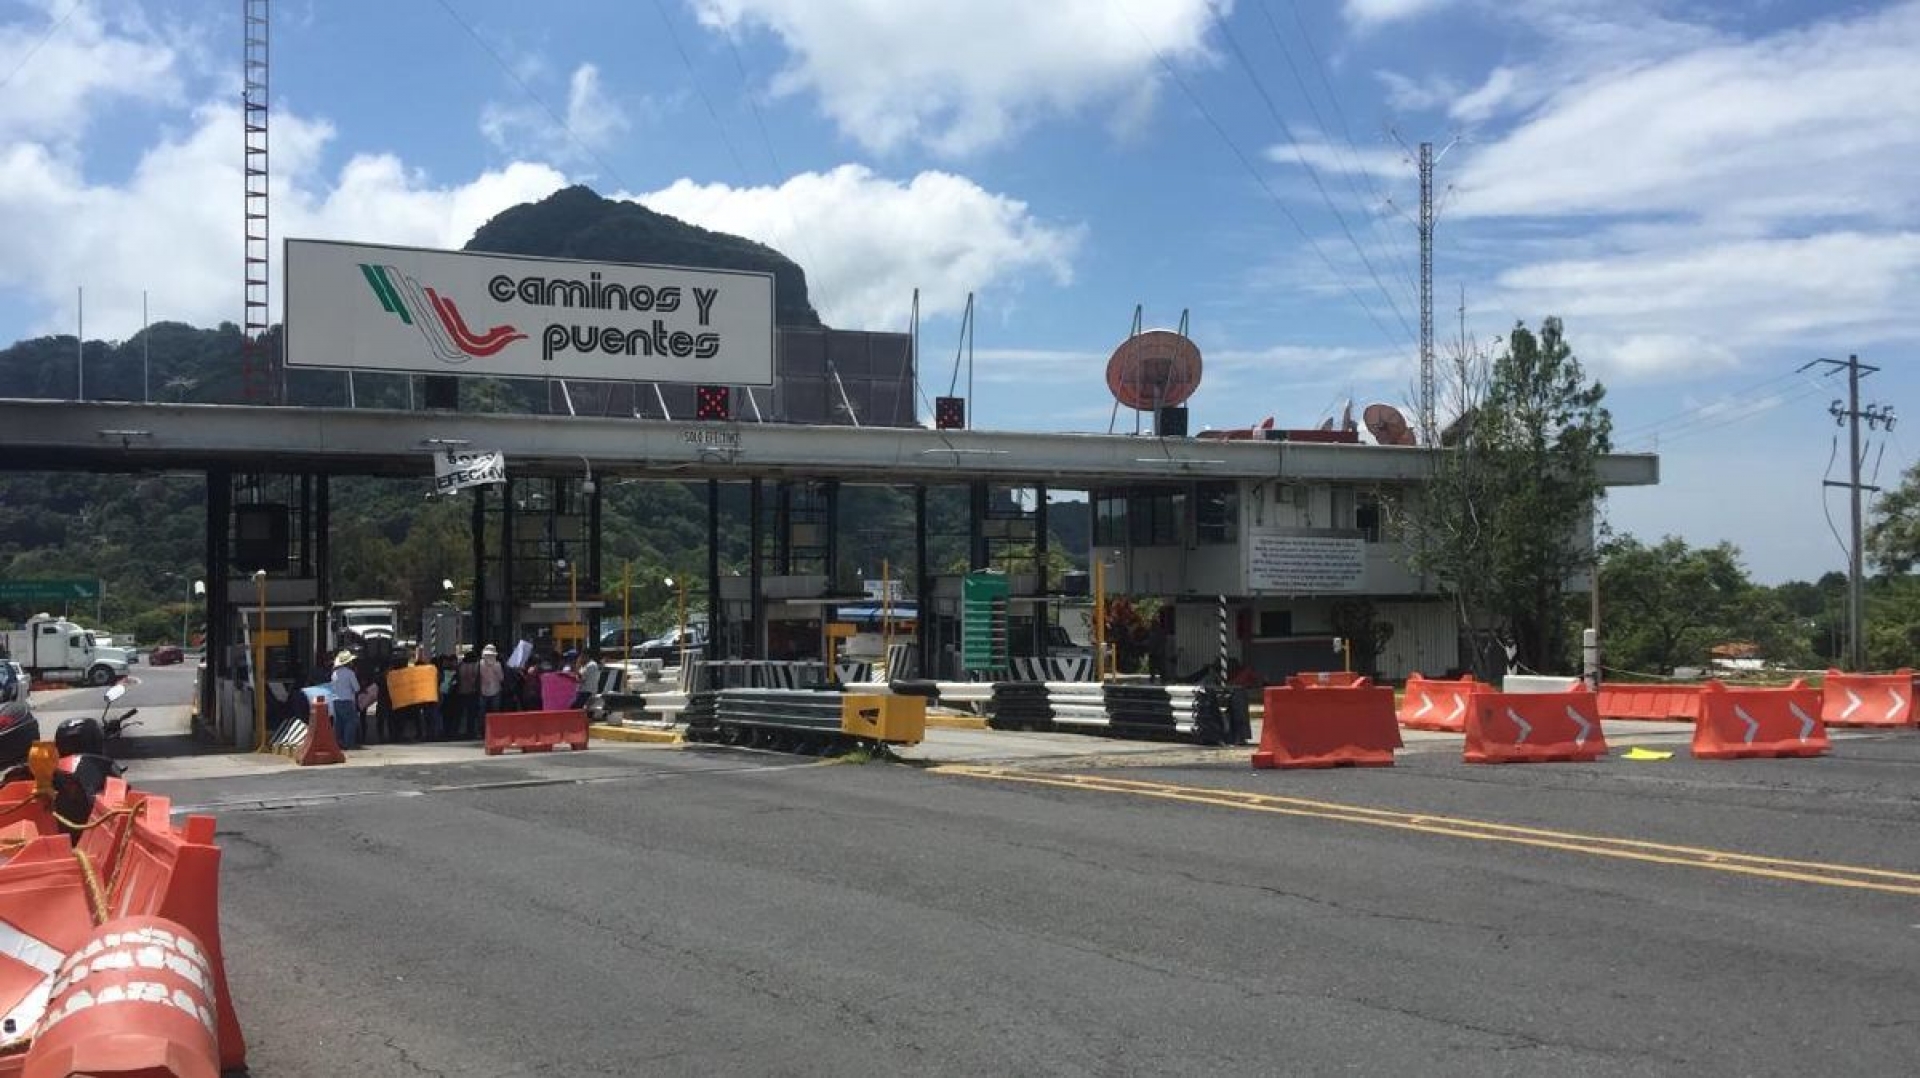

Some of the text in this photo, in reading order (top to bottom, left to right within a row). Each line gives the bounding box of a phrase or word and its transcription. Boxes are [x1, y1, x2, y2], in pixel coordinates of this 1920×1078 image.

[488, 271, 719, 326] caminos Y
[542, 319, 720, 361] puentes
